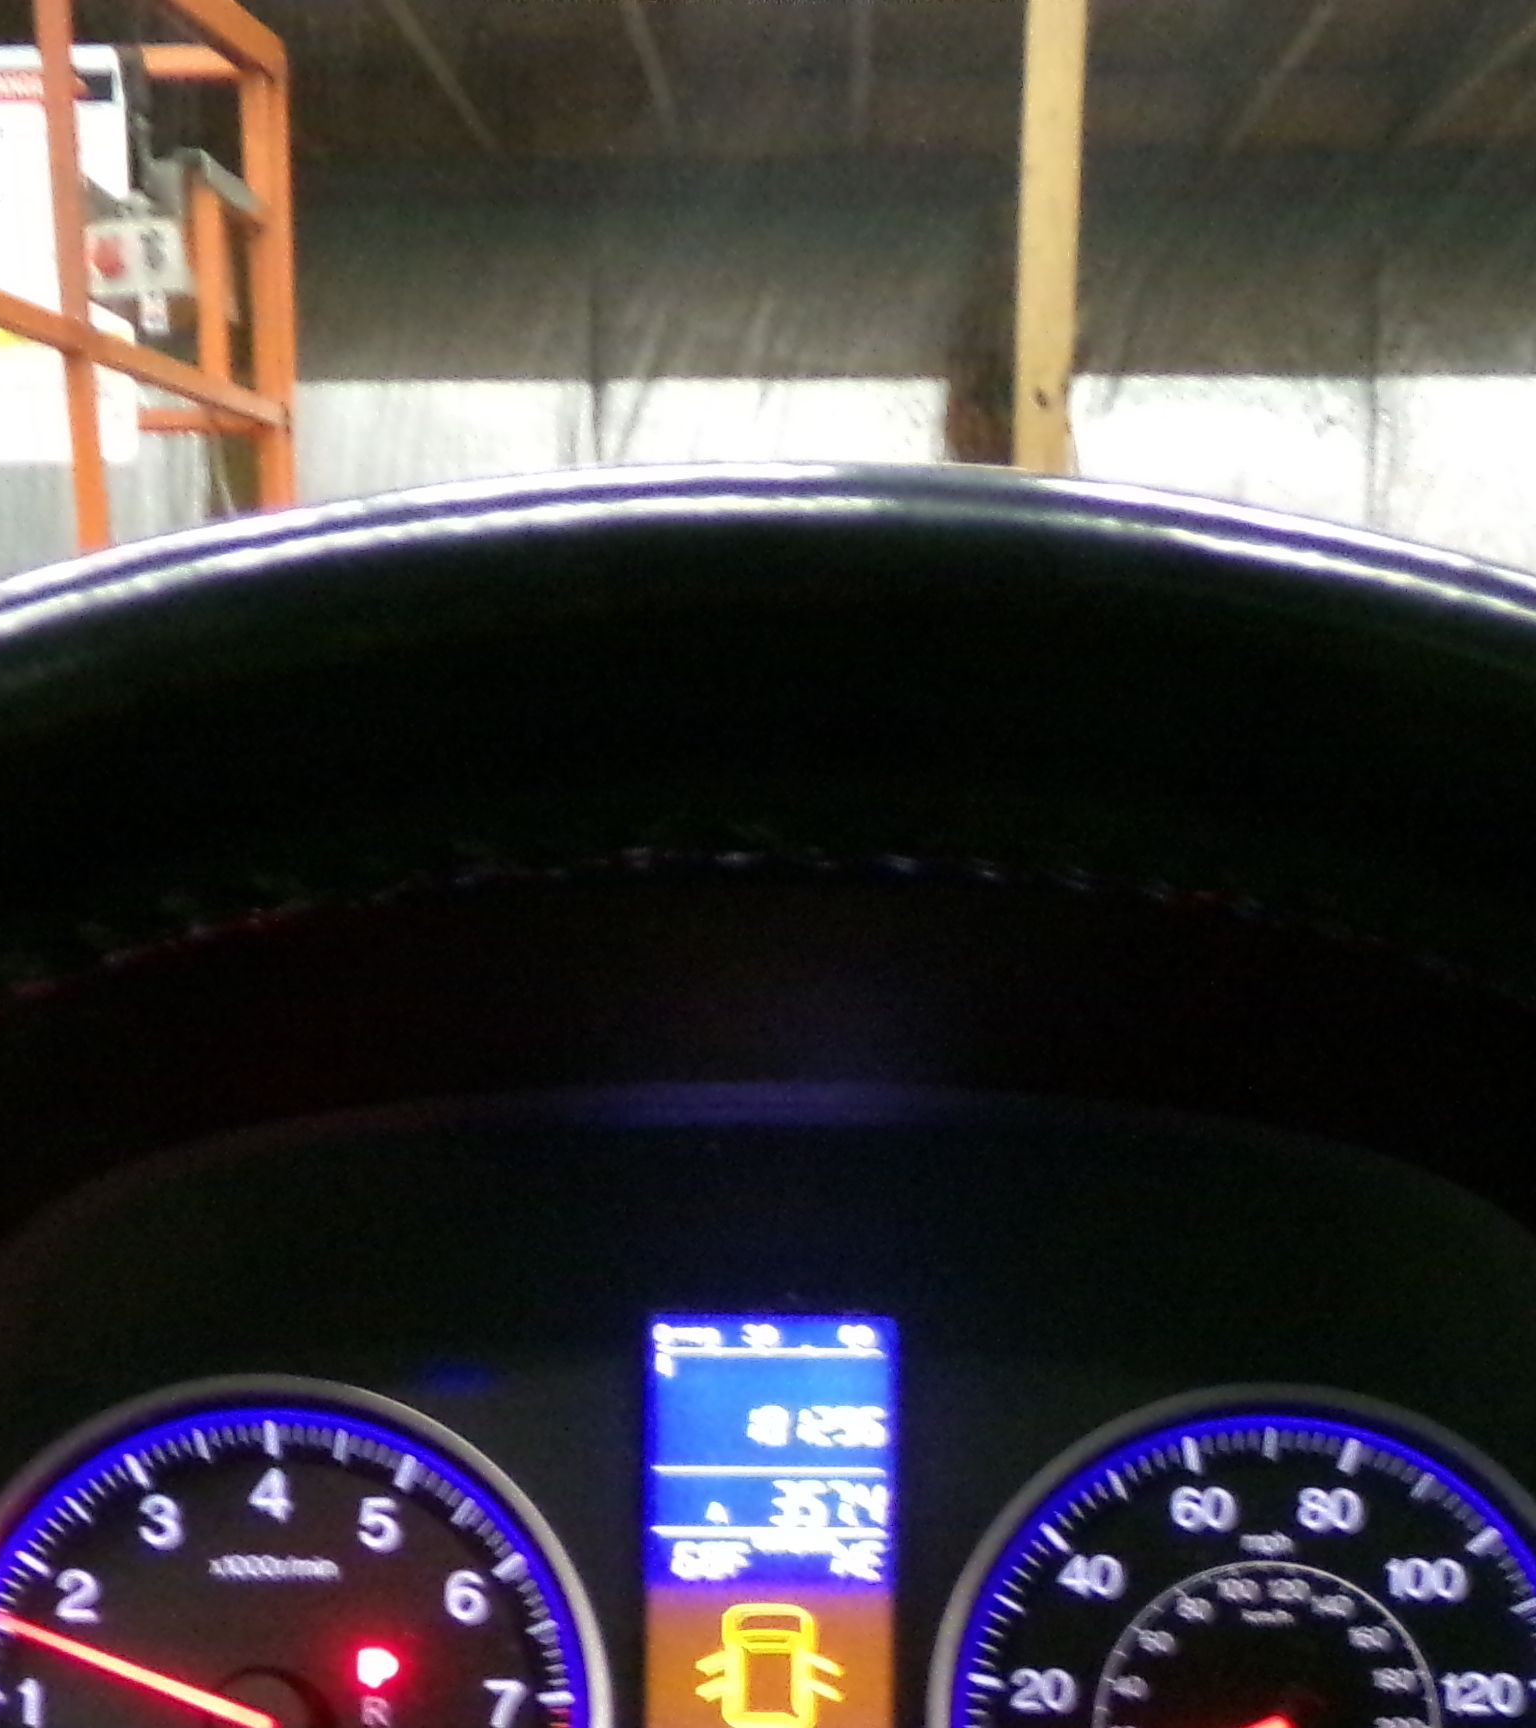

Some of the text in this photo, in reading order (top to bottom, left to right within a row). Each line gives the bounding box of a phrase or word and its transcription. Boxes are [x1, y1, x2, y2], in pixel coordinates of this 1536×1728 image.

[249, 1467, 294, 1523] 4
[1171, 1486, 1240, 1534] 60
[1297, 1486, 1366, 1535] 80
[138, 1494, 186, 1551] 3
[358, 1497, 403, 1553] 5
[54, 1569, 102, 1624] 2
[444, 1571, 490, 1625] 6
[1057, 1553, 1127, 1600] 40
[1385, 1558, 1468, 1603] 100
[1010, 1667, 1077, 1714] 20
[1440, 1671, 1527, 1717] 120
